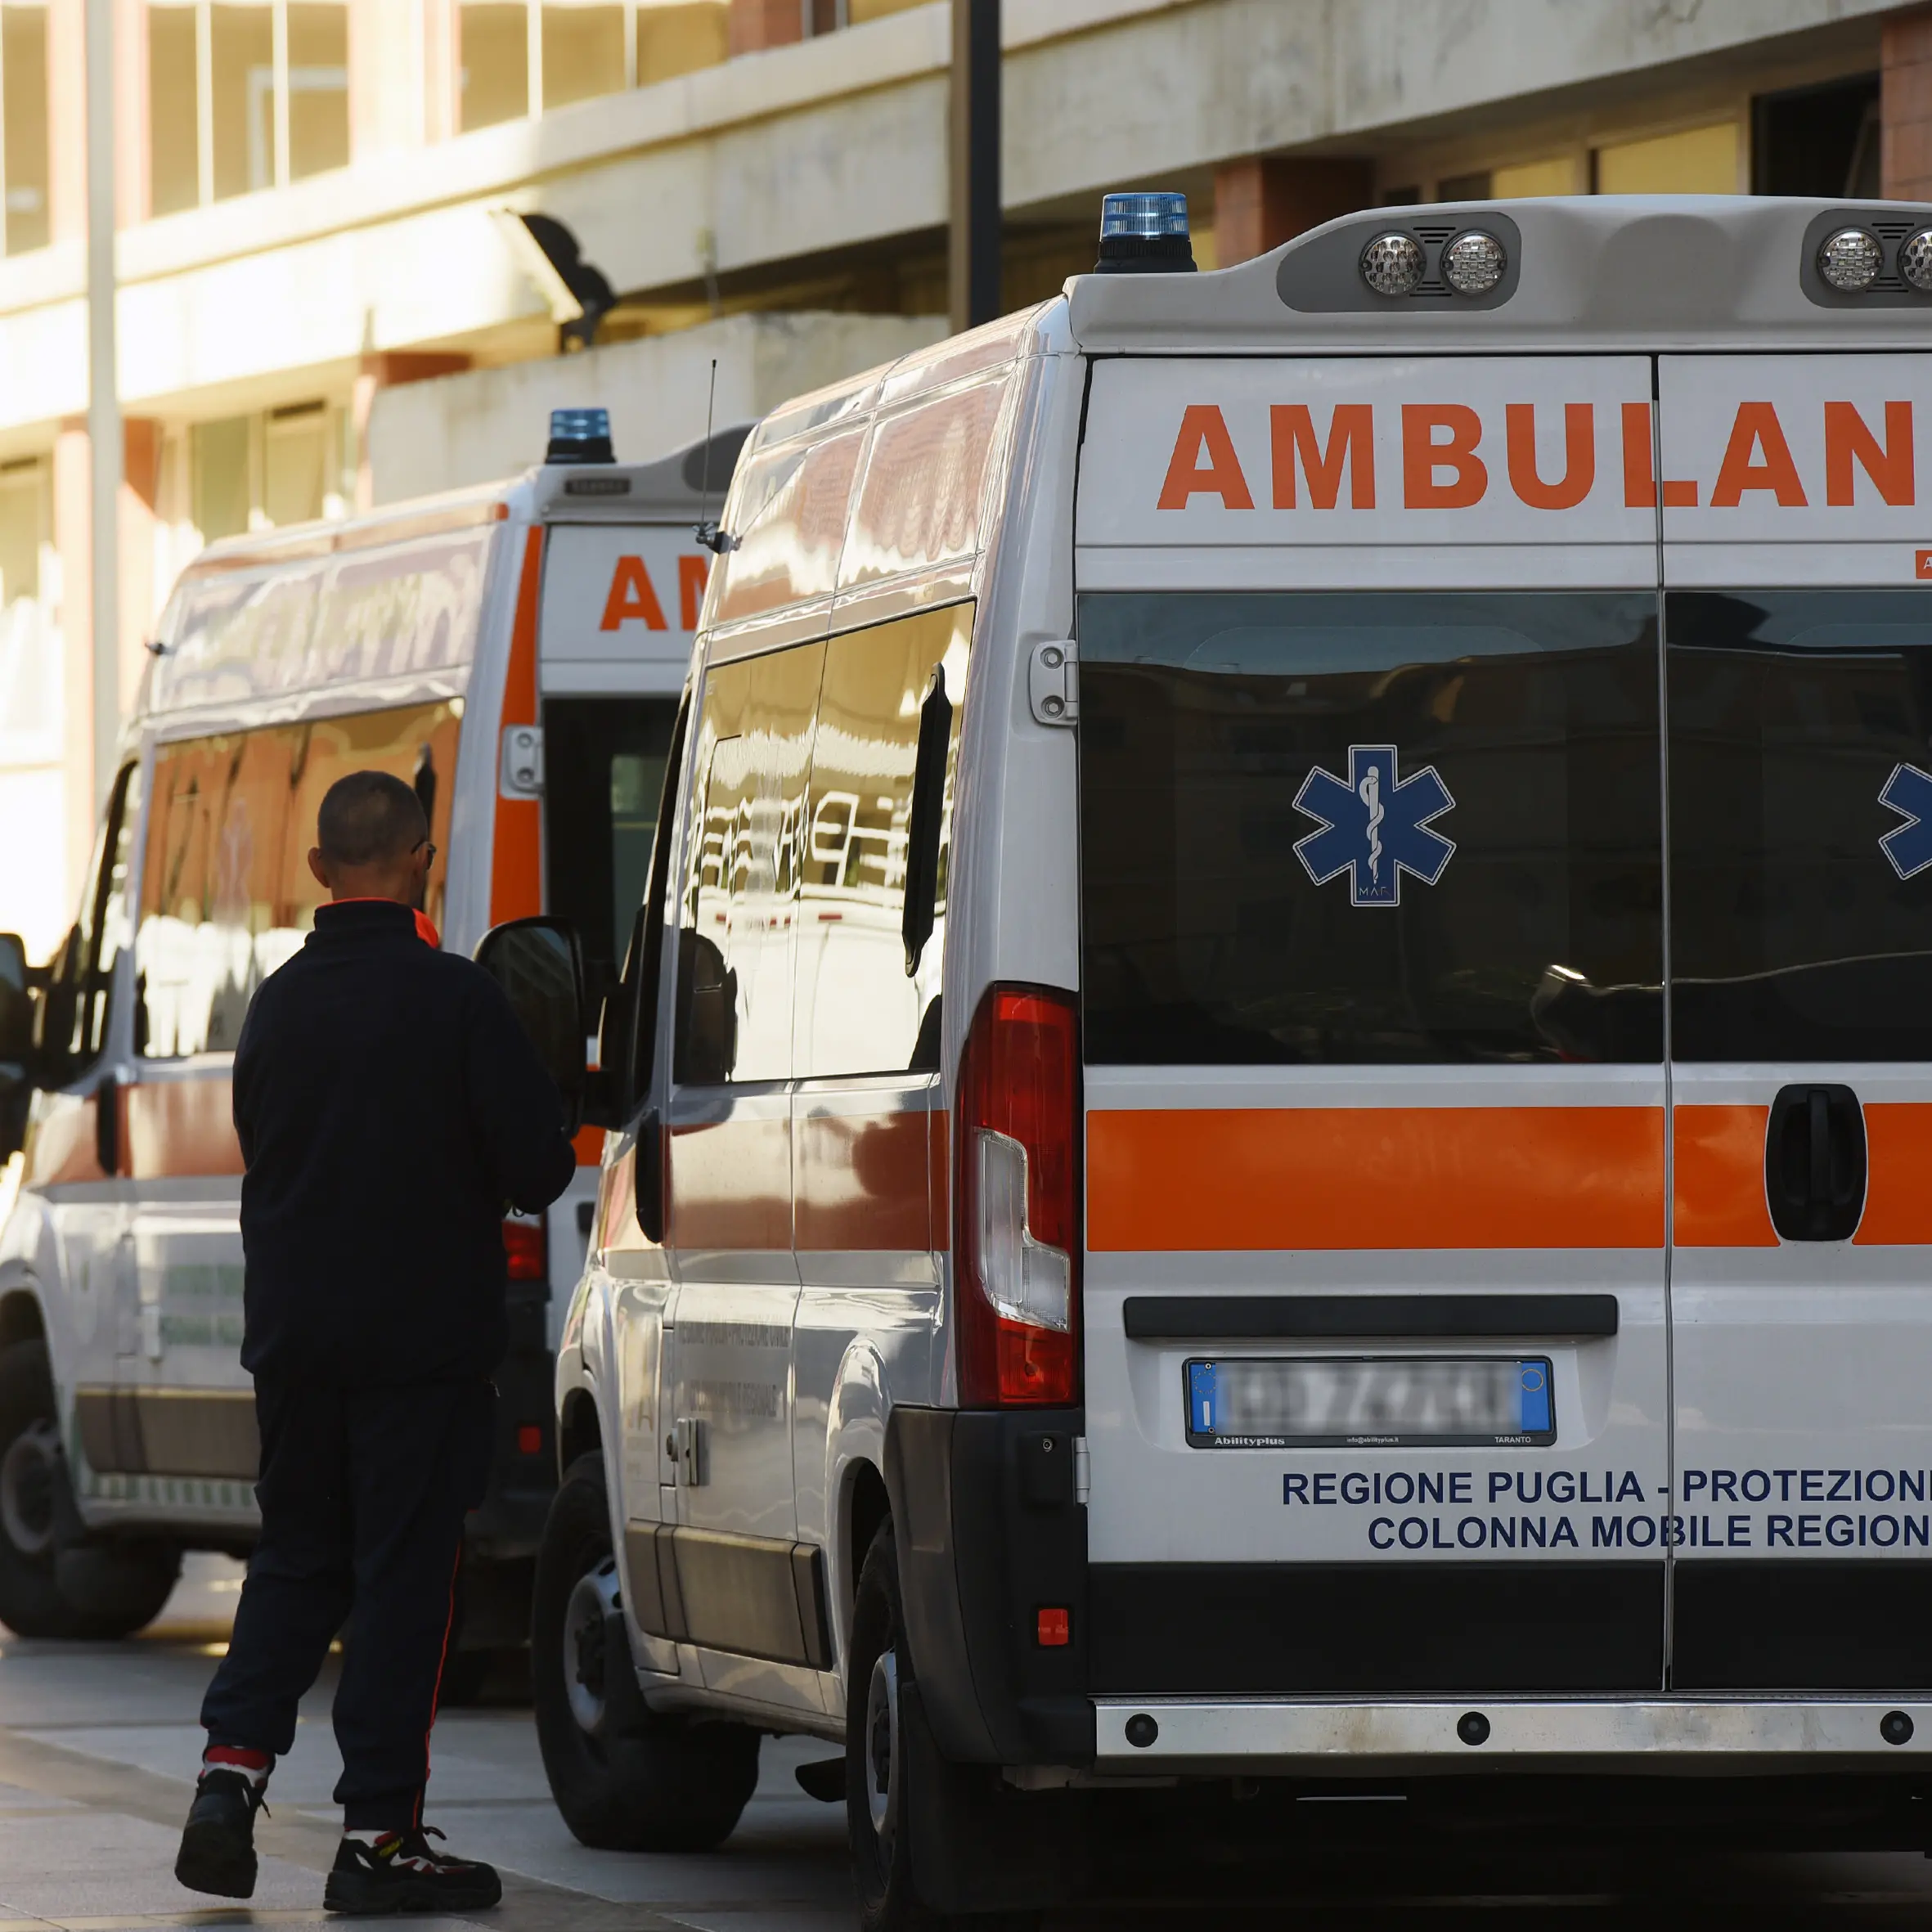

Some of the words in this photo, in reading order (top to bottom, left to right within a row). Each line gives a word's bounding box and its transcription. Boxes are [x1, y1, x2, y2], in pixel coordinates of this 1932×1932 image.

[1214, 1436, 1286, 1447] Abilityplus
[1283, 1471, 1473, 1506] REGIONE
[1488, 1470, 1646, 1504] PUGLIA
[1683, 1469, 1932, 1503] PROTEZION
[1368, 1516, 1579, 1549] COLONNA
[1592, 1514, 1751, 1548] MOBILE
[1767, 1514, 1929, 1547] REGION
